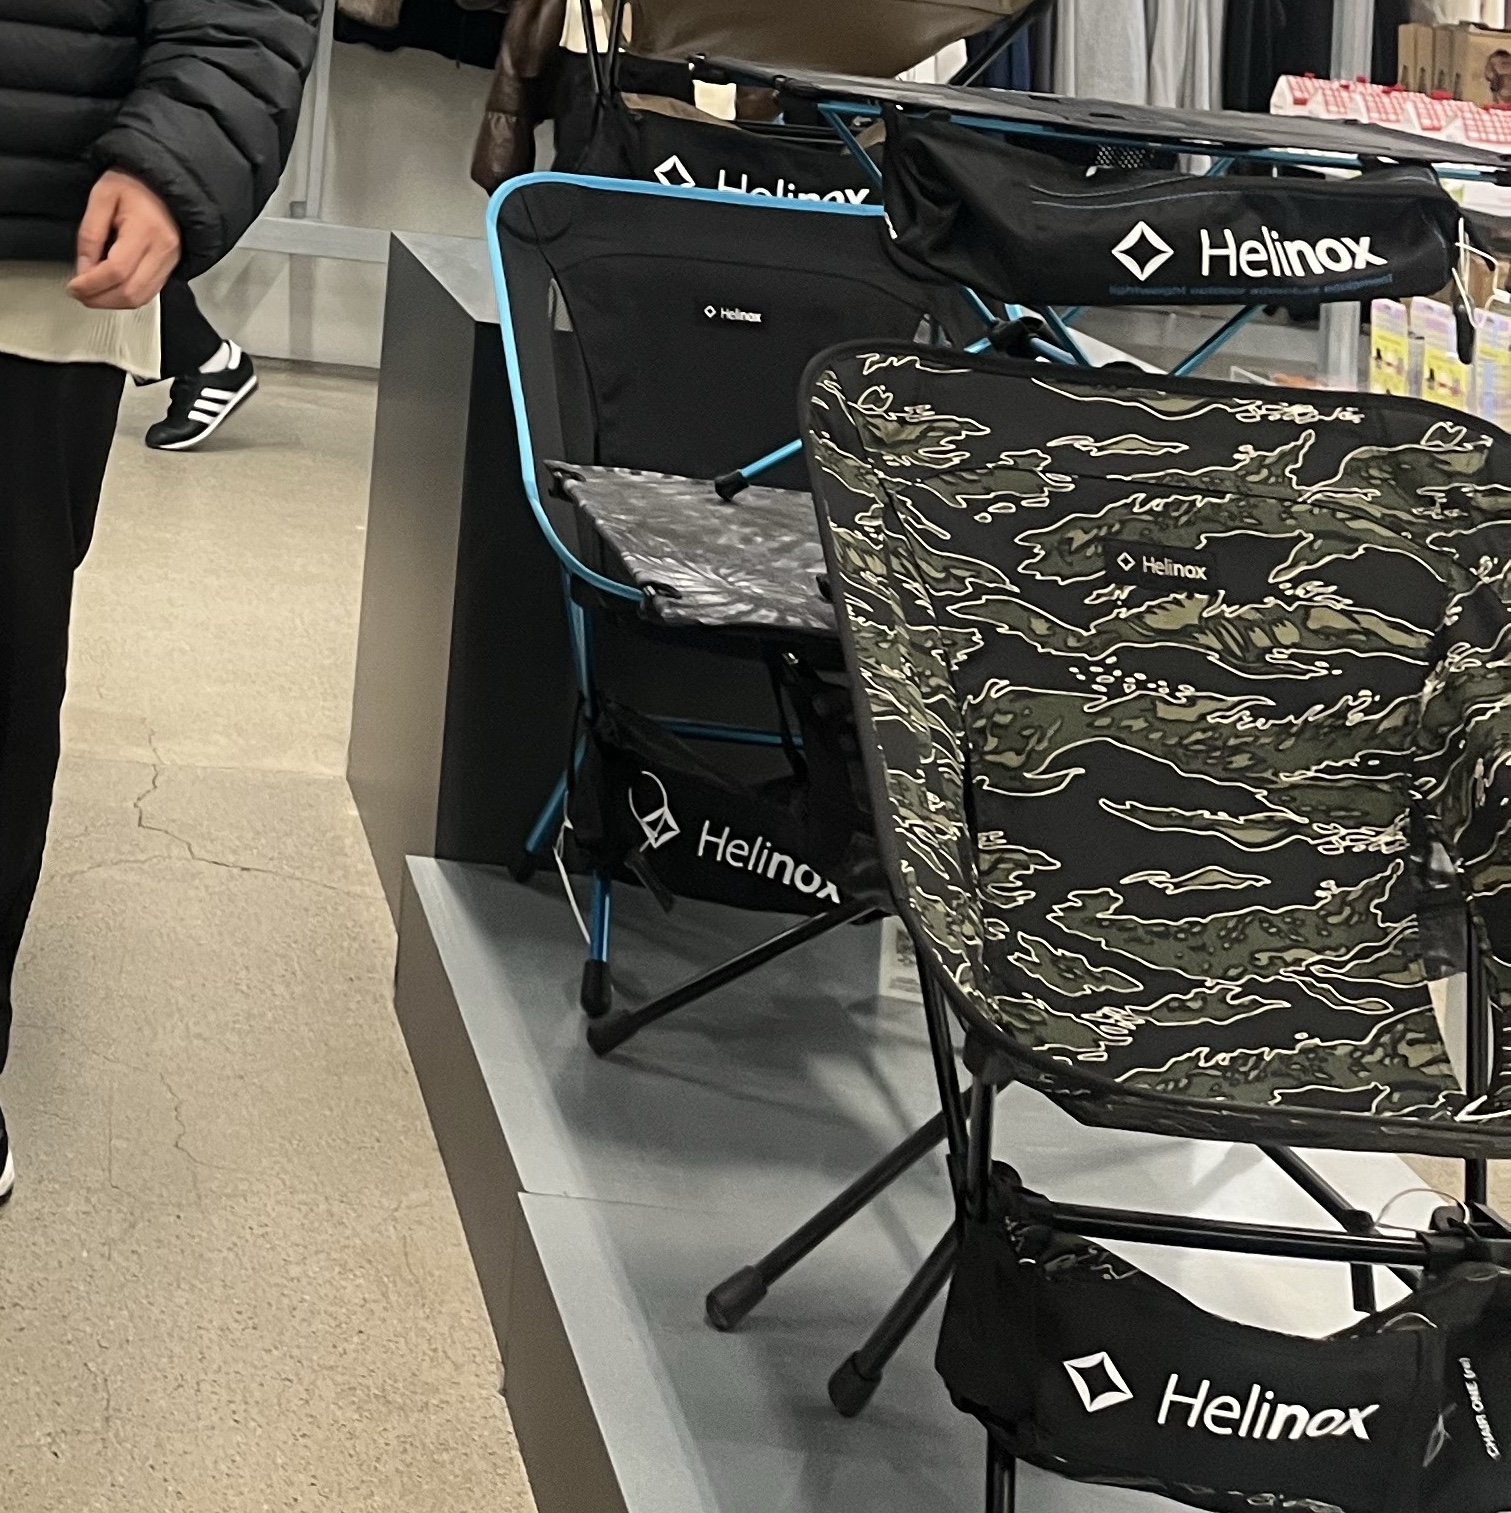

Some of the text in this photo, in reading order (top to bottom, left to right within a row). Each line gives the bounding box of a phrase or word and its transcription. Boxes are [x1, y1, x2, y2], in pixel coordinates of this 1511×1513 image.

[1199, 225, 1388, 278] Helinox
[720, 307, 762, 323] Helinox
[1142, 555, 1207, 581] Helinox
[696, 819, 841, 904] Helinox
[1156, 1373, 1381, 1441] Helinox
[1465, 1380, 1484, 1412] ONE
